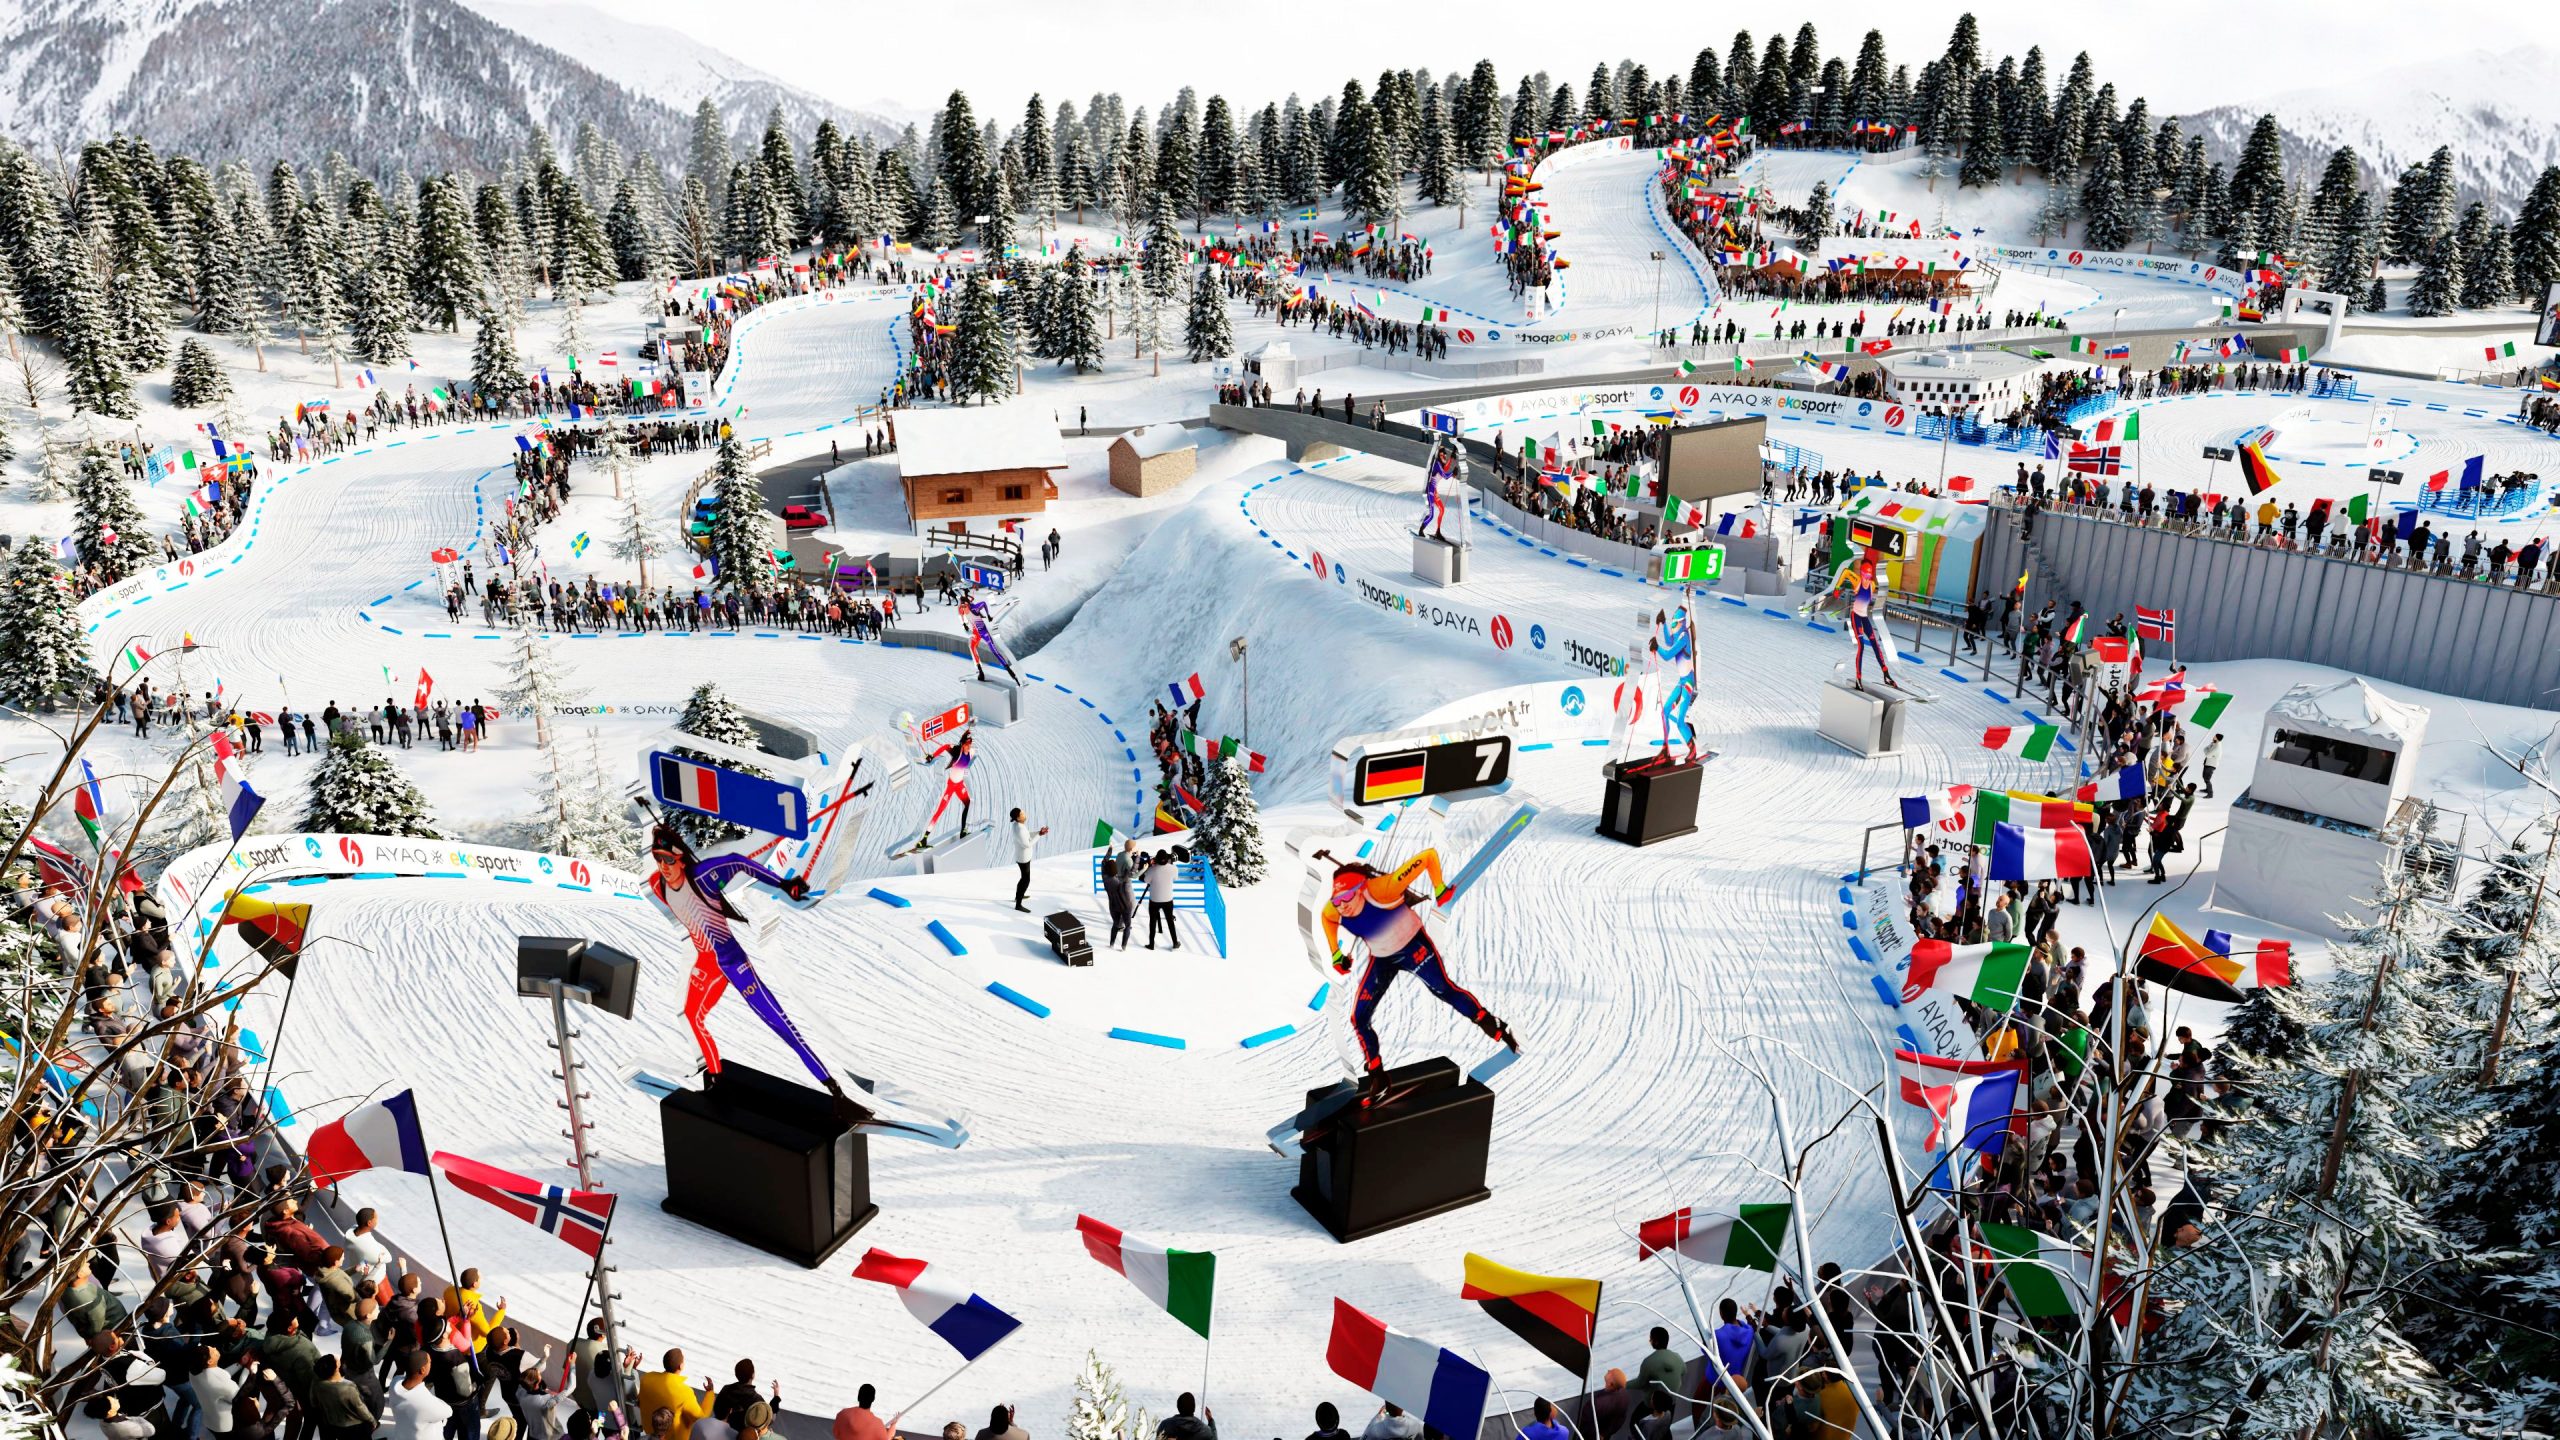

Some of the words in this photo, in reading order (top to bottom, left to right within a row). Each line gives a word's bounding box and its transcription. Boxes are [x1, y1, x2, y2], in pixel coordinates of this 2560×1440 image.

[2090, 256, 2124, 267] AYAQ
[1520, 396, 1557, 412] AYAQ
[1709, 392, 1758, 406] AYAQ
[1447, 417, 1454, 432] 8
[1888, 533, 1901, 554] 4
[1705, 552, 1719, 575] 5
[986, 572, 1000, 587] 12
[956, 706, 966, 724] 6
[1474, 741, 1504, 783] 7
[777, 790, 798, 832] 1
[375, 845, 430, 867] AYAQ
[600, 872, 640, 896] AYAQ
[1917, 1000, 1955, 1055] AYAQ
